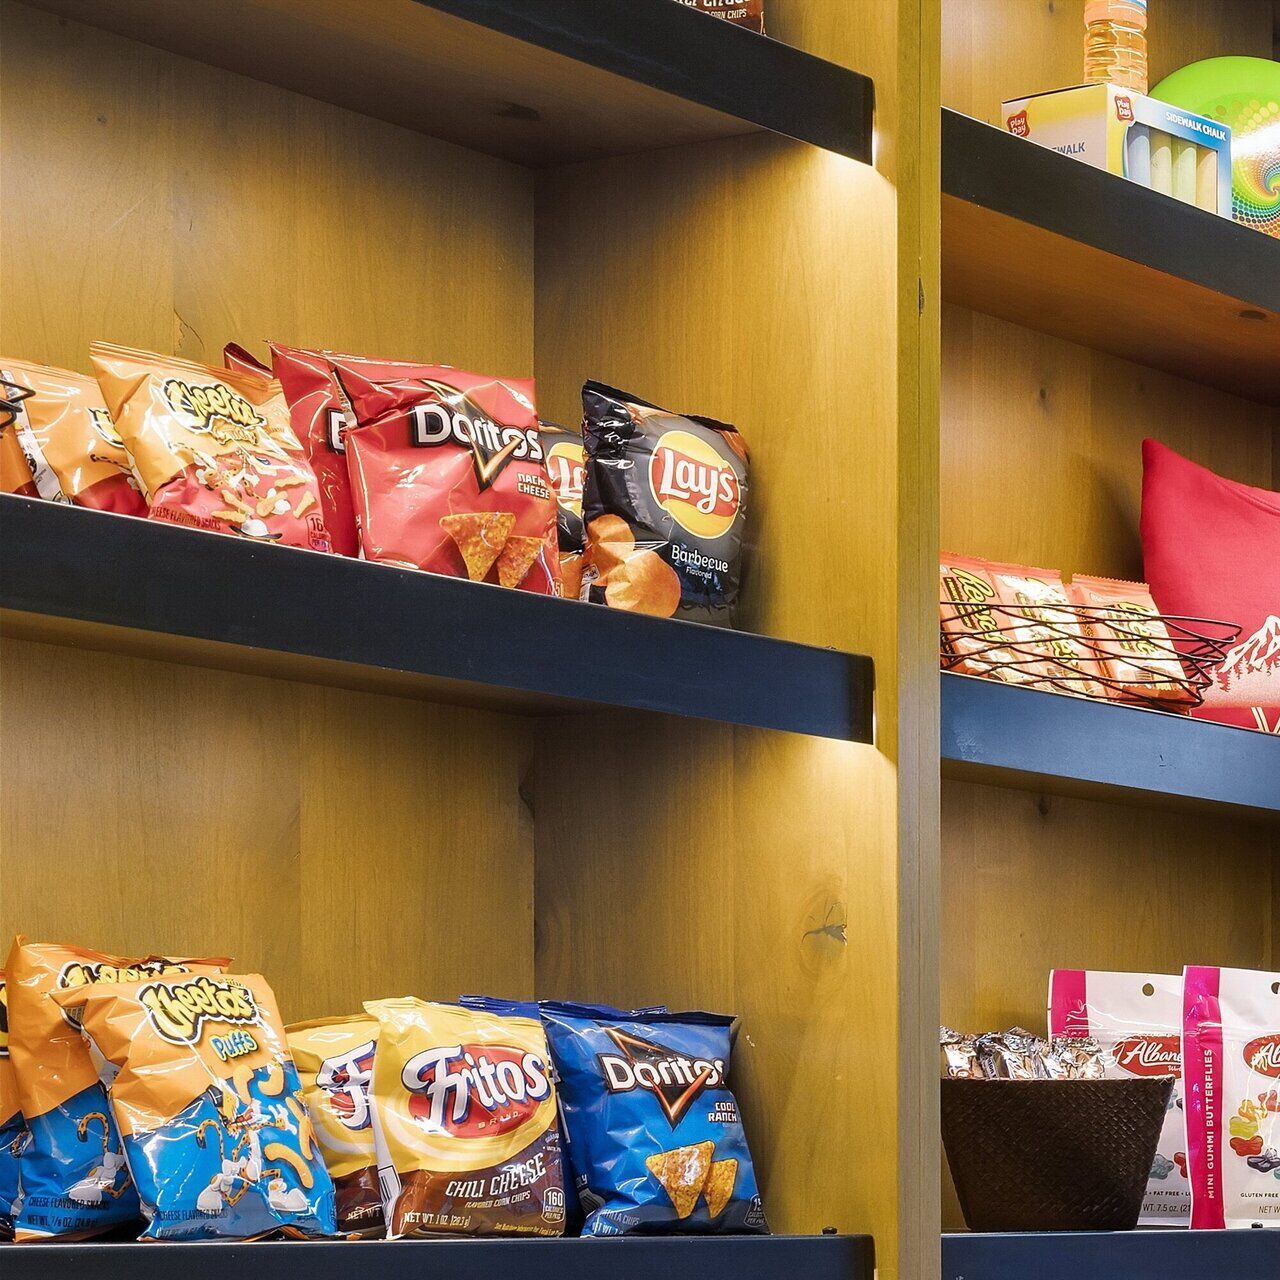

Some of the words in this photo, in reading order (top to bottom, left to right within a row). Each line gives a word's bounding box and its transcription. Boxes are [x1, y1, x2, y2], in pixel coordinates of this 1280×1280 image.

[727, 8, 747, 19] CHIPS
[1166, 111, 1203, 133] SIDEWALK
[1203, 124, 1227, 142] CHALK
[413, 404, 545, 461] Doritos
[517, 484, 551, 500] CHEESE
[659, 448, 735, 514] Lay's
[671, 544, 729, 574] Barbecue
[139, 977, 255, 1043] Cheetos
[210, 1028, 259, 1061] Puffs
[601, 1055, 725, 1090] Doritos
[402, 1045, 552, 1135] Fritos
[1205, 1048, 1216, 1129] BUTTERFLIES
[708, 1112, 738, 1123] RANCH
[715, 1101, 736, 1112] COOL
[1206, 1133, 1216, 1171] GUMMI
[445, 1179, 486, 1199] CHILI
[489, 1152, 547, 1196] CHEESE
[1206, 1175, 1216, 1200] MINI
[510, 1190, 531, 1204] CHIPS
[547, 1192, 563, 1207] 160
[1258, 1206, 1271, 1215] NET
[404, 1212, 420, 1224] NET
